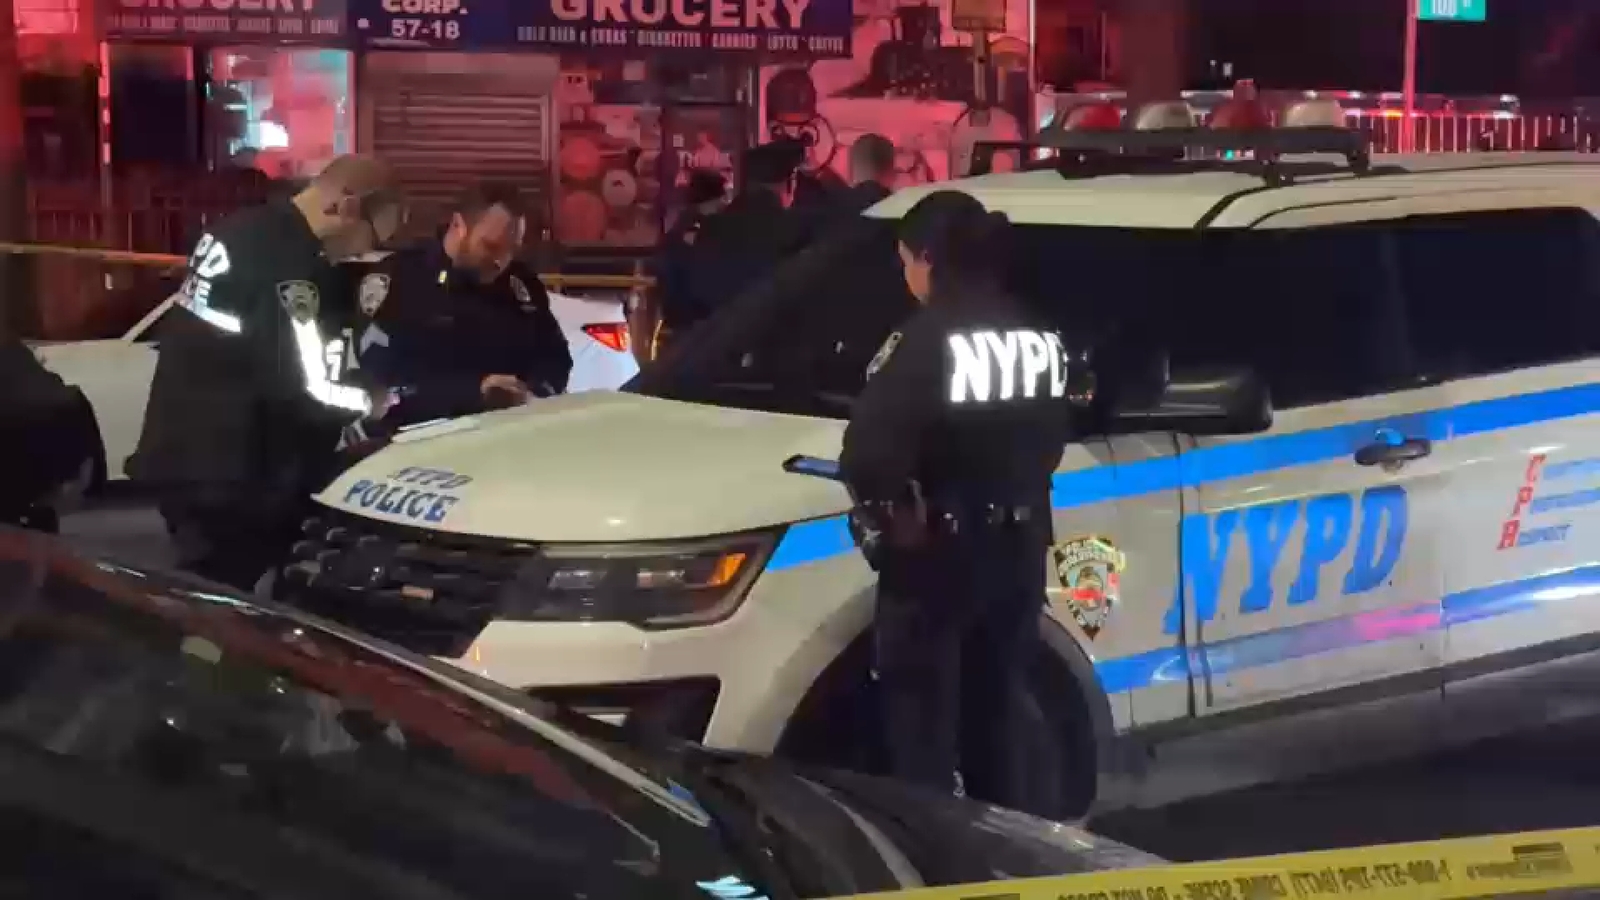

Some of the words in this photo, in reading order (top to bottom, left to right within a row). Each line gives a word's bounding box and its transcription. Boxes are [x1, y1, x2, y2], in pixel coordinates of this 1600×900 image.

[382, 0, 468, 15] CORP.
[392, 18, 461, 39] 57-18
[947, 330, 1068, 403] NYPD
[387, 466, 474, 489] NYPD
[343, 479, 460, 522] POLICE
[1162, 484, 1408, 634] NYPD
